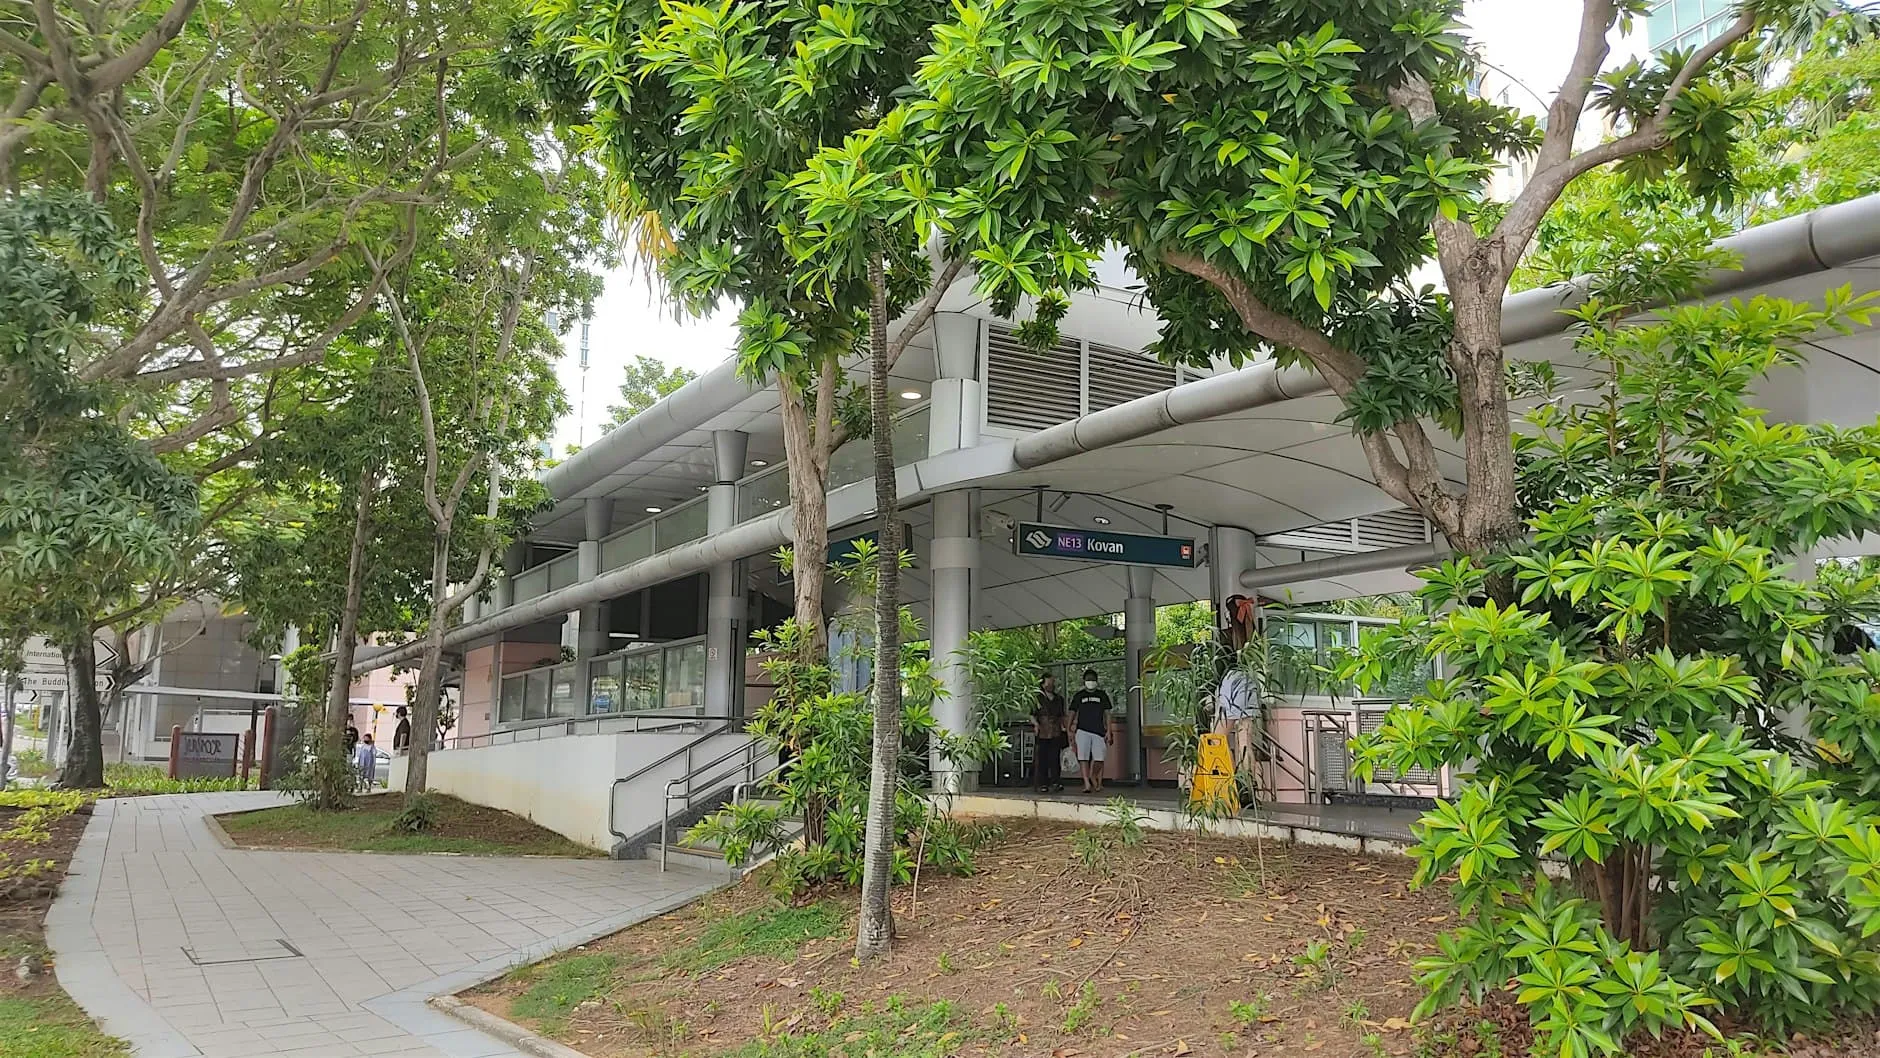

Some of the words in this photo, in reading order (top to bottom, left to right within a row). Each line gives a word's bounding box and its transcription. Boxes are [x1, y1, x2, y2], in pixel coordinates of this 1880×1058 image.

[1057, 536, 1082, 549] NE13
[1087, 538, 1124, 554] Kovan
[42, 678, 68, 686] Buddh
